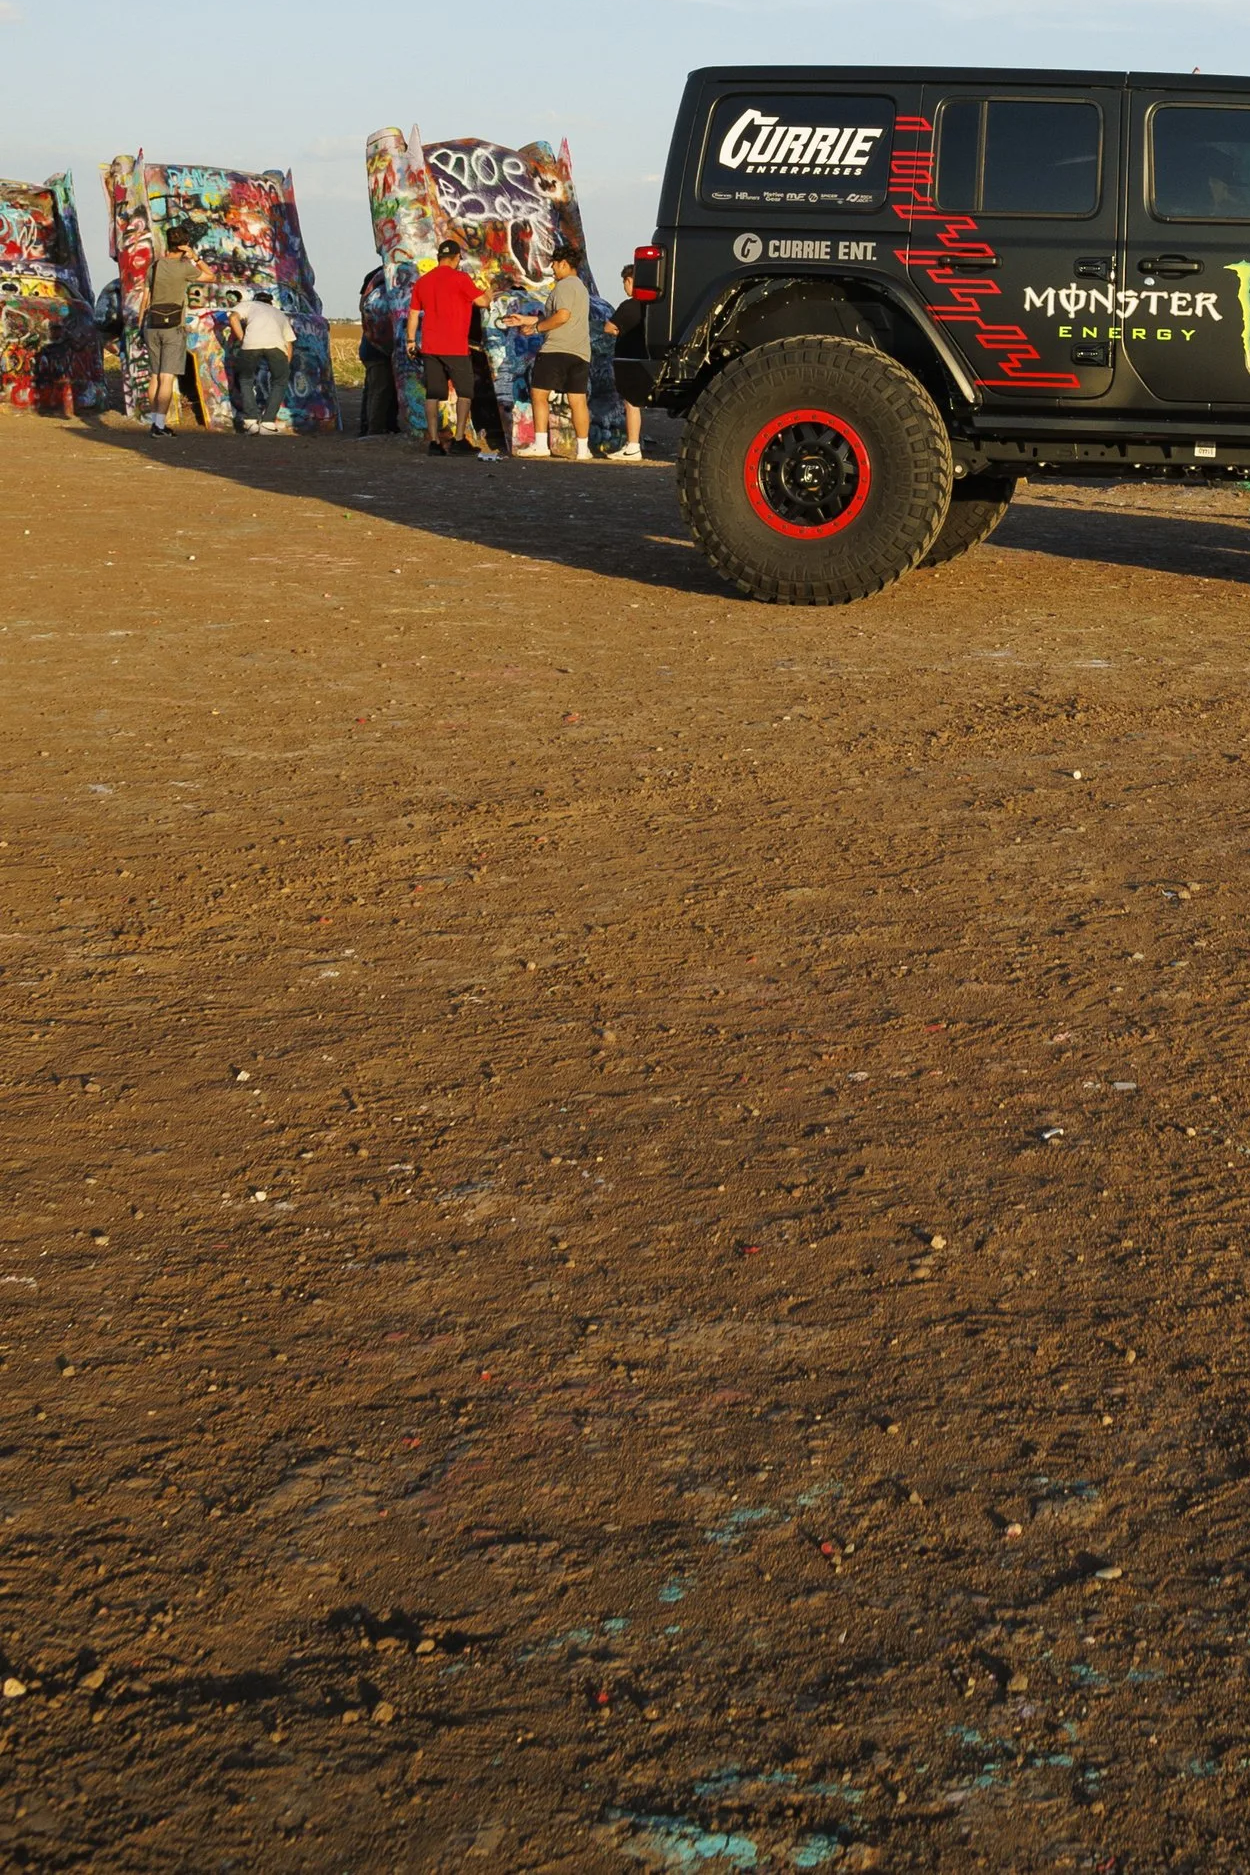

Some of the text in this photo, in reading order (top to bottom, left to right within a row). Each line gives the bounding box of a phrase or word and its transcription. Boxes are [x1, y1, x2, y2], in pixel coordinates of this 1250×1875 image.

[719, 108, 884, 169] CURRIE
[745, 165, 863, 176] ENTERPRISES
[768, 239, 831, 260] CURRIE
[838, 241, 877, 261] ENT.
[1023, 282, 1223, 321] MONSTER
[1058, 326, 1196, 341] ENERGY
